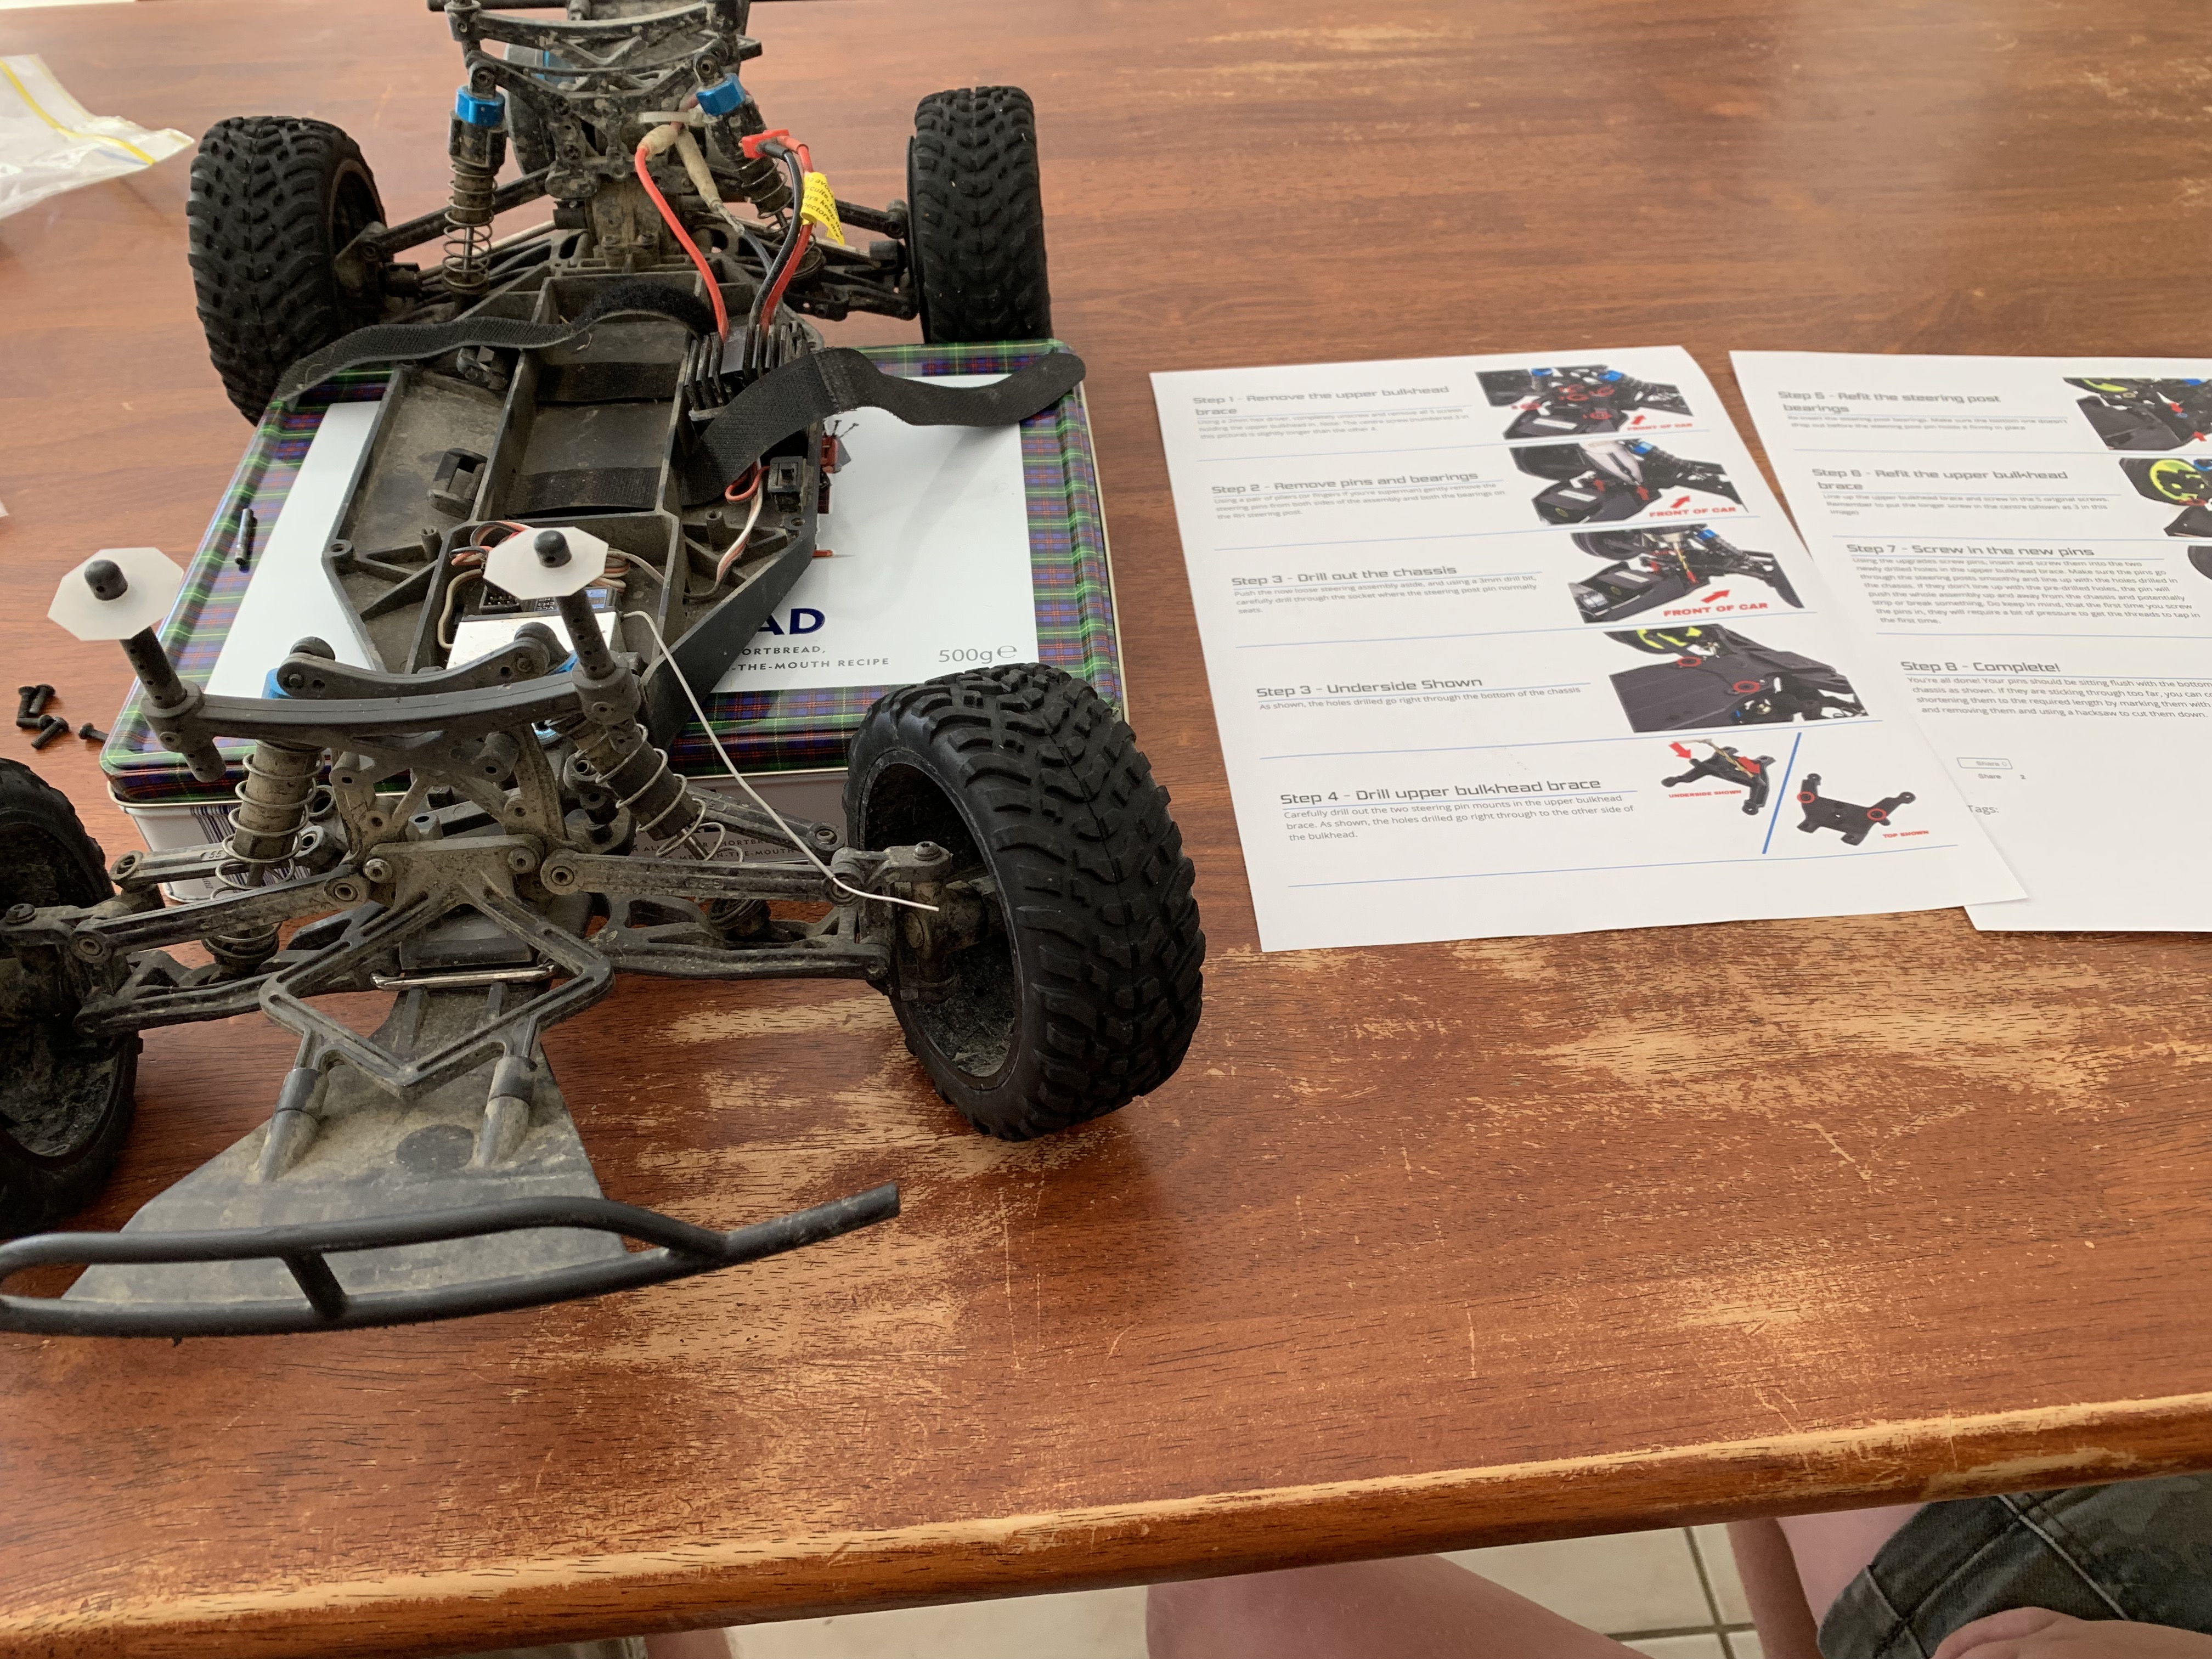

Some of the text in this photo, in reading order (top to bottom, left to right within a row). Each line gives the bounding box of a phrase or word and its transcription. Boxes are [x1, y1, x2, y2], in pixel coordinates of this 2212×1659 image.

[803, 203, 831, 222] nectors
[1335, 391, 1378, 400] upper
[1381, 386, 1450, 397] bulkhead
[1778, 391, 1812, 401] Step
[1837, 392, 1871, 401] Refit
[1873, 393, 1899, 402] the
[1901, 394, 1965, 404] steering
[1966, 396, 2001, 404] post
[1782, 403, 1850, 414] bearings
[1812, 469, 1848, 479] Step
[1875, 470, 1911, 478] Refit
[1913, 470, 1939, 478] the
[1943, 472, 1989, 481] upper
[1992, 471, 2069, 479] bulkhead
[1211, 486, 1246, 494] Step
[1250, 484, 1260, 492] 2
[1274, 481, 1336, 490] Remove
[1340, 478, 1374, 489] pins
[1377, 476, 1407, 485] and
[1409, 473, 1479, 483] bearings
[1817, 481, 1864, 490] brace
[1649, 508, 1689, 518] FRONT
[1846, 544, 1884, 555] Step
[1887, 544, 1896, 553] 7
[1911, 545, 1963, 554] Screw
[1967, 546, 1984, 554] in
[1986, 546, 2015, 555] the
[2057, 547, 2095, 557] pins
[1231, 578, 1268, 586] Step
[1272, 575, 1283, 584] 3
[1297, 572, 1328, 582] Drill
[1331, 572, 1359, 580] out
[1362, 570, 1389, 579] the
[1392, 566, 1457, 577] chassis
[1663, 607, 1711, 617] FRONT
[1739, 602, 1768, 611] CAR
[742, 646, 826, 656] ORTBREAD,
[939, 648, 994, 664] 500g
[731, 658, 890, 671] -THE-MOUTH RECIPE
[1900, 661, 1942, 674] Step
[1944, 662, 1958, 672] 8
[1972, 662, 2061, 674] Complete!
[1256, 688, 1295, 698] Step
[1300, 685, 1312, 695] 3
[1327, 681, 1417, 694] Underside
[1421, 679, 1483, 690] Shown
[1398, 696, 1422, 704] right
[1423, 694, 1462, 702] through
[1547, 687, 1581, 695] chassis
[1942, 707, 1989, 715] removing
[2039, 709, 2067, 717] using
[1280, 794, 1322, 805] Step
[1328, 792, 1339, 801] 4
[1356, 789, 1390, 800] Drill
[1395, 788, 1449, 800] upper
[1454, 781, 1543, 795] bulkhead
[1546, 781, 1601, 791] brace
[1284, 810, 1328, 819] Carefully
[1330, 808, 1349, 816] drill
[1410, 804, 1453, 812] steering
[1454, 803, 1470, 811] pin
[1544, 798, 1573, 806] upper
[1575, 794, 1623, 804] bulkhead
[1967, 804, 2000, 815] Tags:
[1421, 814, 1453, 822] drilled
[1455, 815, 1469, 823] go
[1470, 812, 1495, 822] right
[1496, 810, 1537, 820] through
[1571, 807, 1598, 815] other
[1307, 831, 1358, 840] bulkhead.
[208, 850, 223, 859] 55
